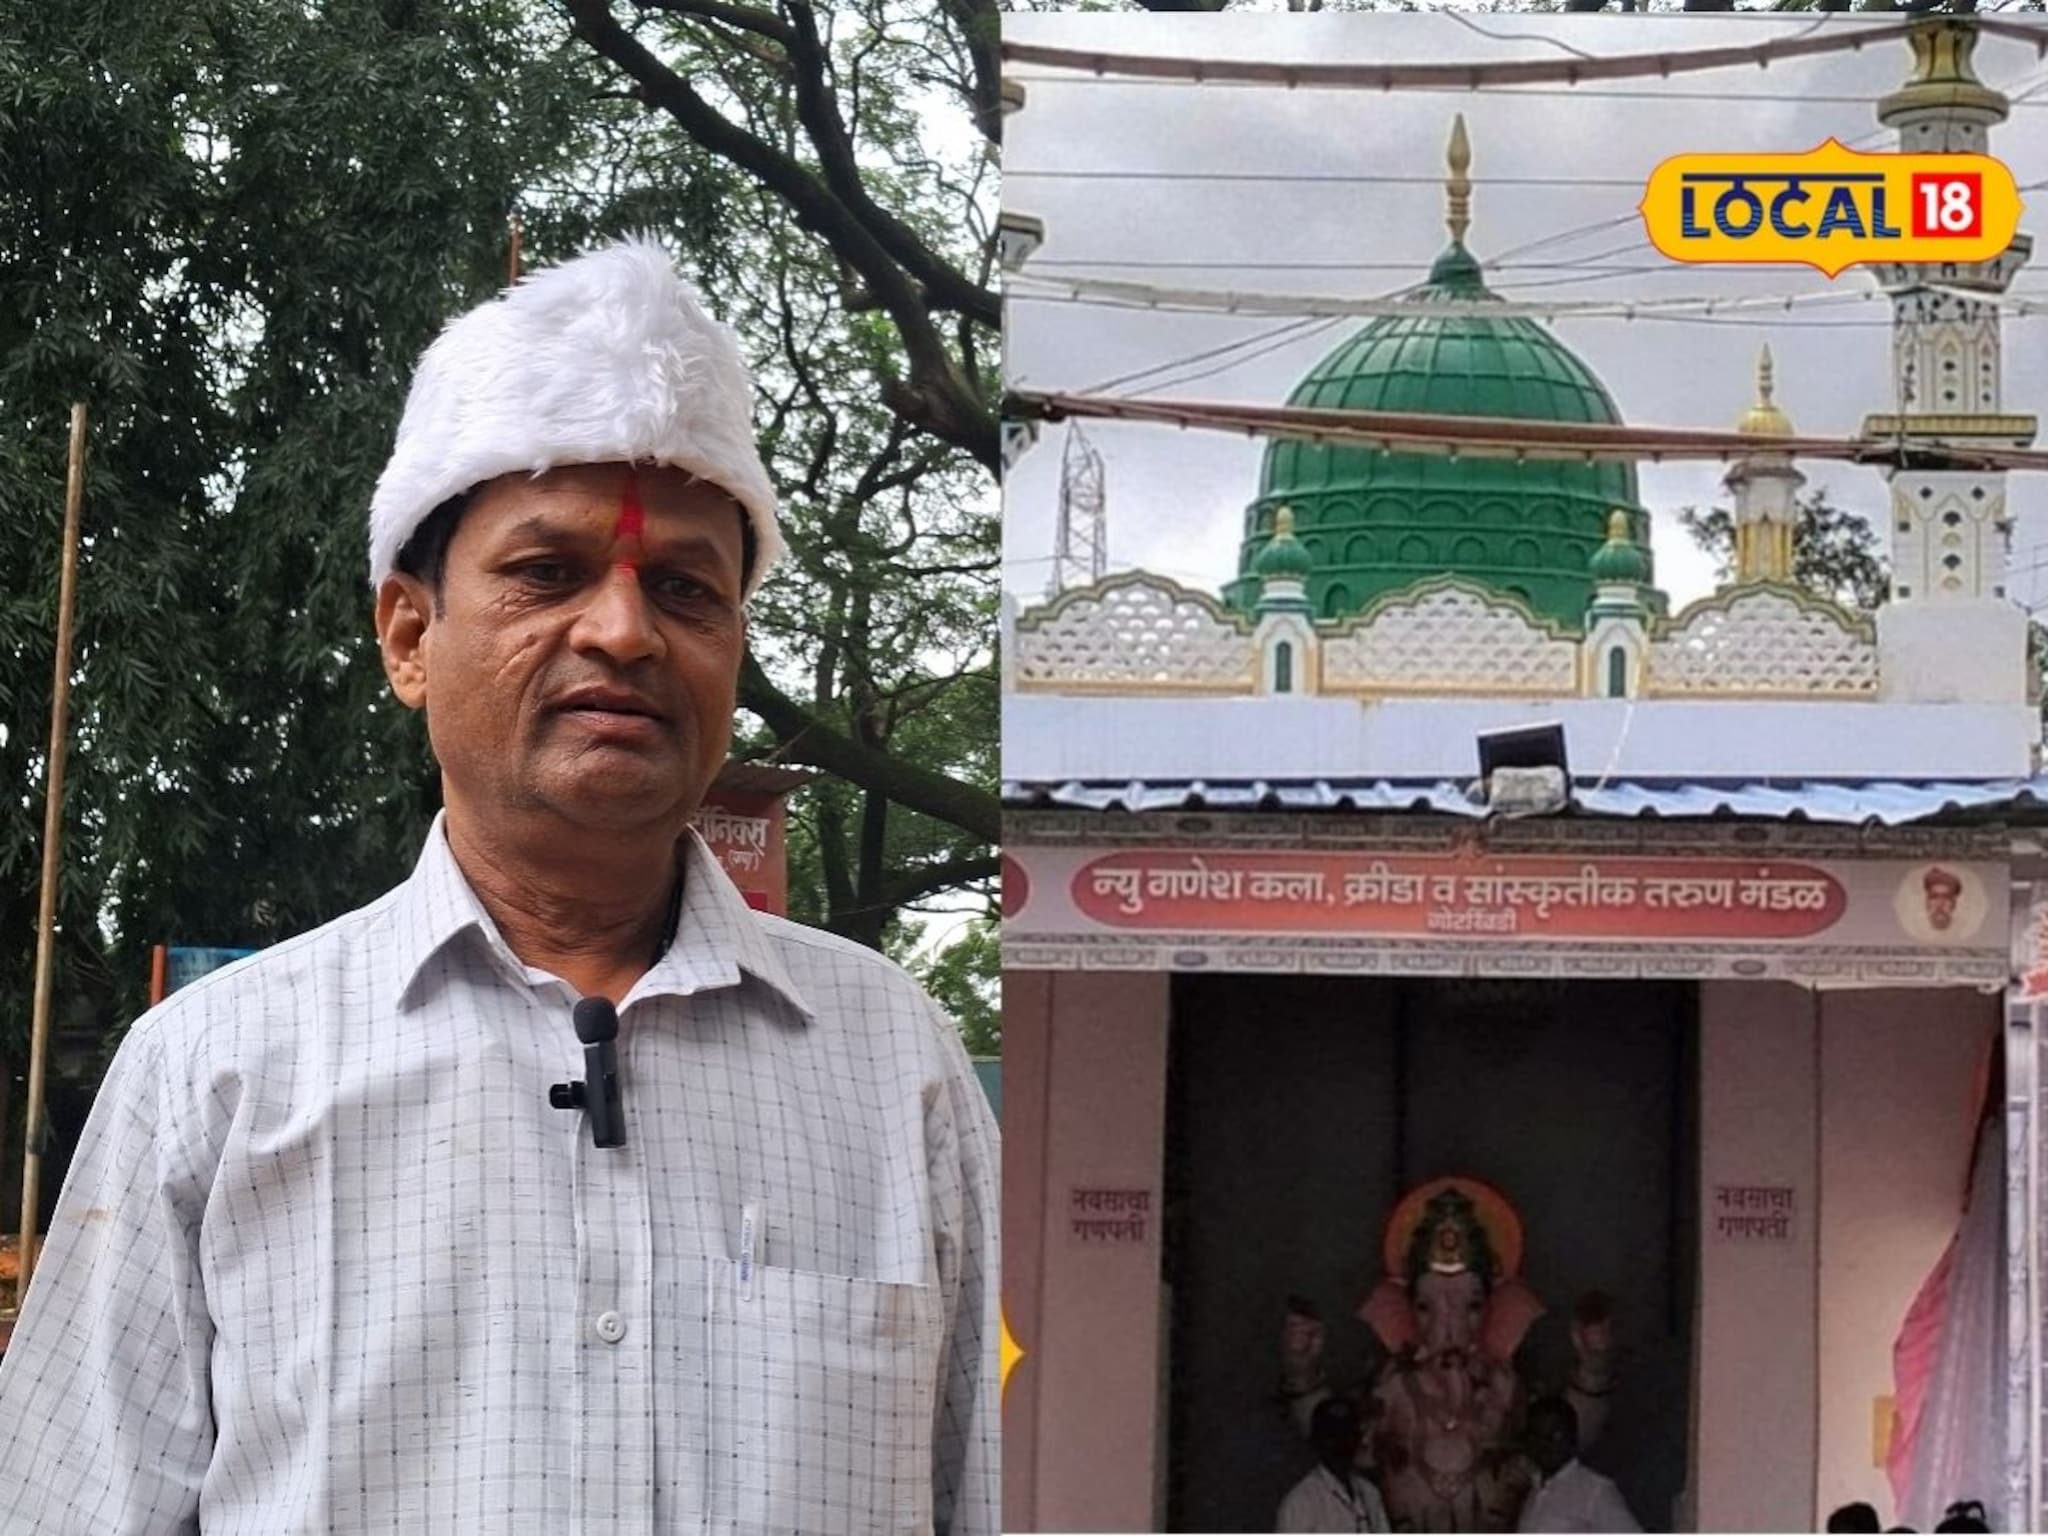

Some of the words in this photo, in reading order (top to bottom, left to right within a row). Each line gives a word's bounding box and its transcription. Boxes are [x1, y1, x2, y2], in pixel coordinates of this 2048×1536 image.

[1093, 867, 1144, 914] न्यु
[1149, 857, 1242, 900] गणेश
[1250, 872, 1336, 905] कला,
[1344, 861, 1425, 906] क्रीडा
[1432, 876, 1456, 903] व
[1465, 864, 1637, 918] सांस्कृतीक
[1643, 878, 1734, 909] तरुण
[1739, 869, 1829, 910] मंडळ
[1072, 1212, 1144, 1241] गणपती
[1718, 1209, 1788, 1238] गणपती
